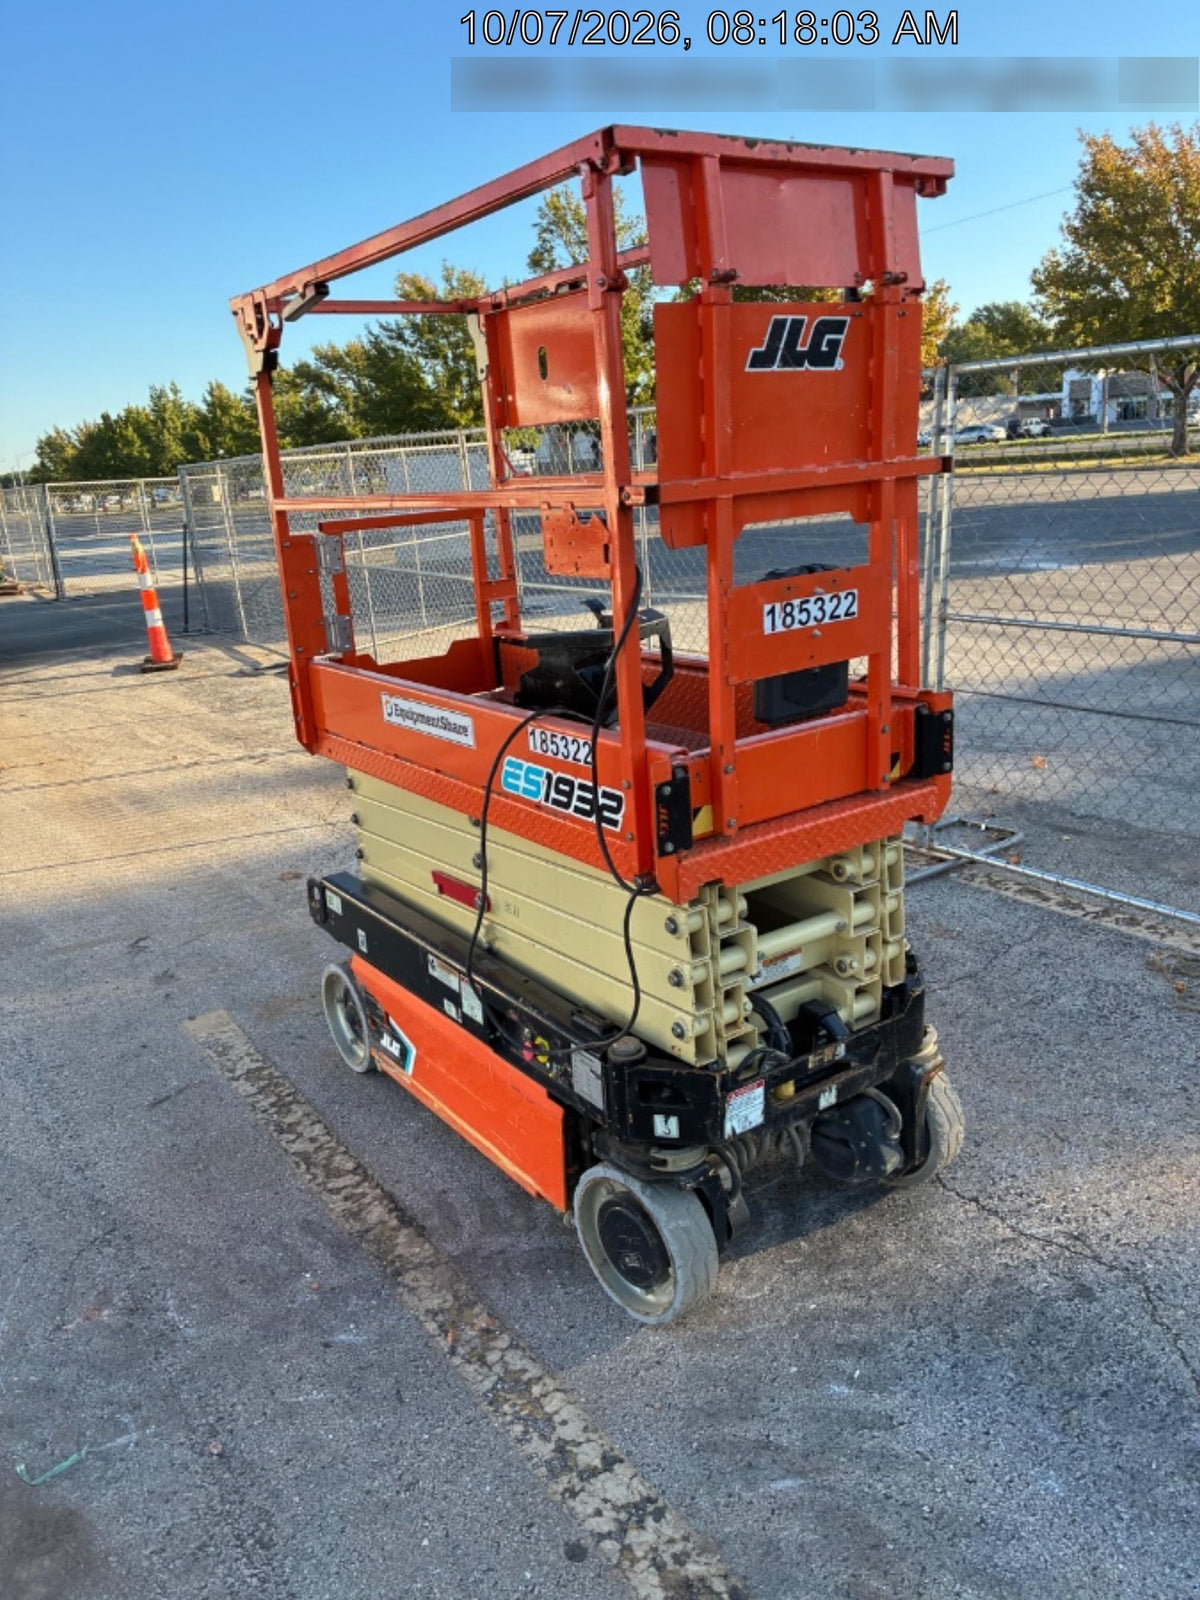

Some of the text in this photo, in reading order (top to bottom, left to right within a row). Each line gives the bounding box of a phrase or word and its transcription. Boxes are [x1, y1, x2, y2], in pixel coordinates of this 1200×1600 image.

[745, 315, 850, 371] JLG
[766, 591, 857, 632] 185322
[394, 703, 469, 737] EquipmentShare
[529, 728, 593, 766] 185322
[502, 757, 624, 830] ES1932
